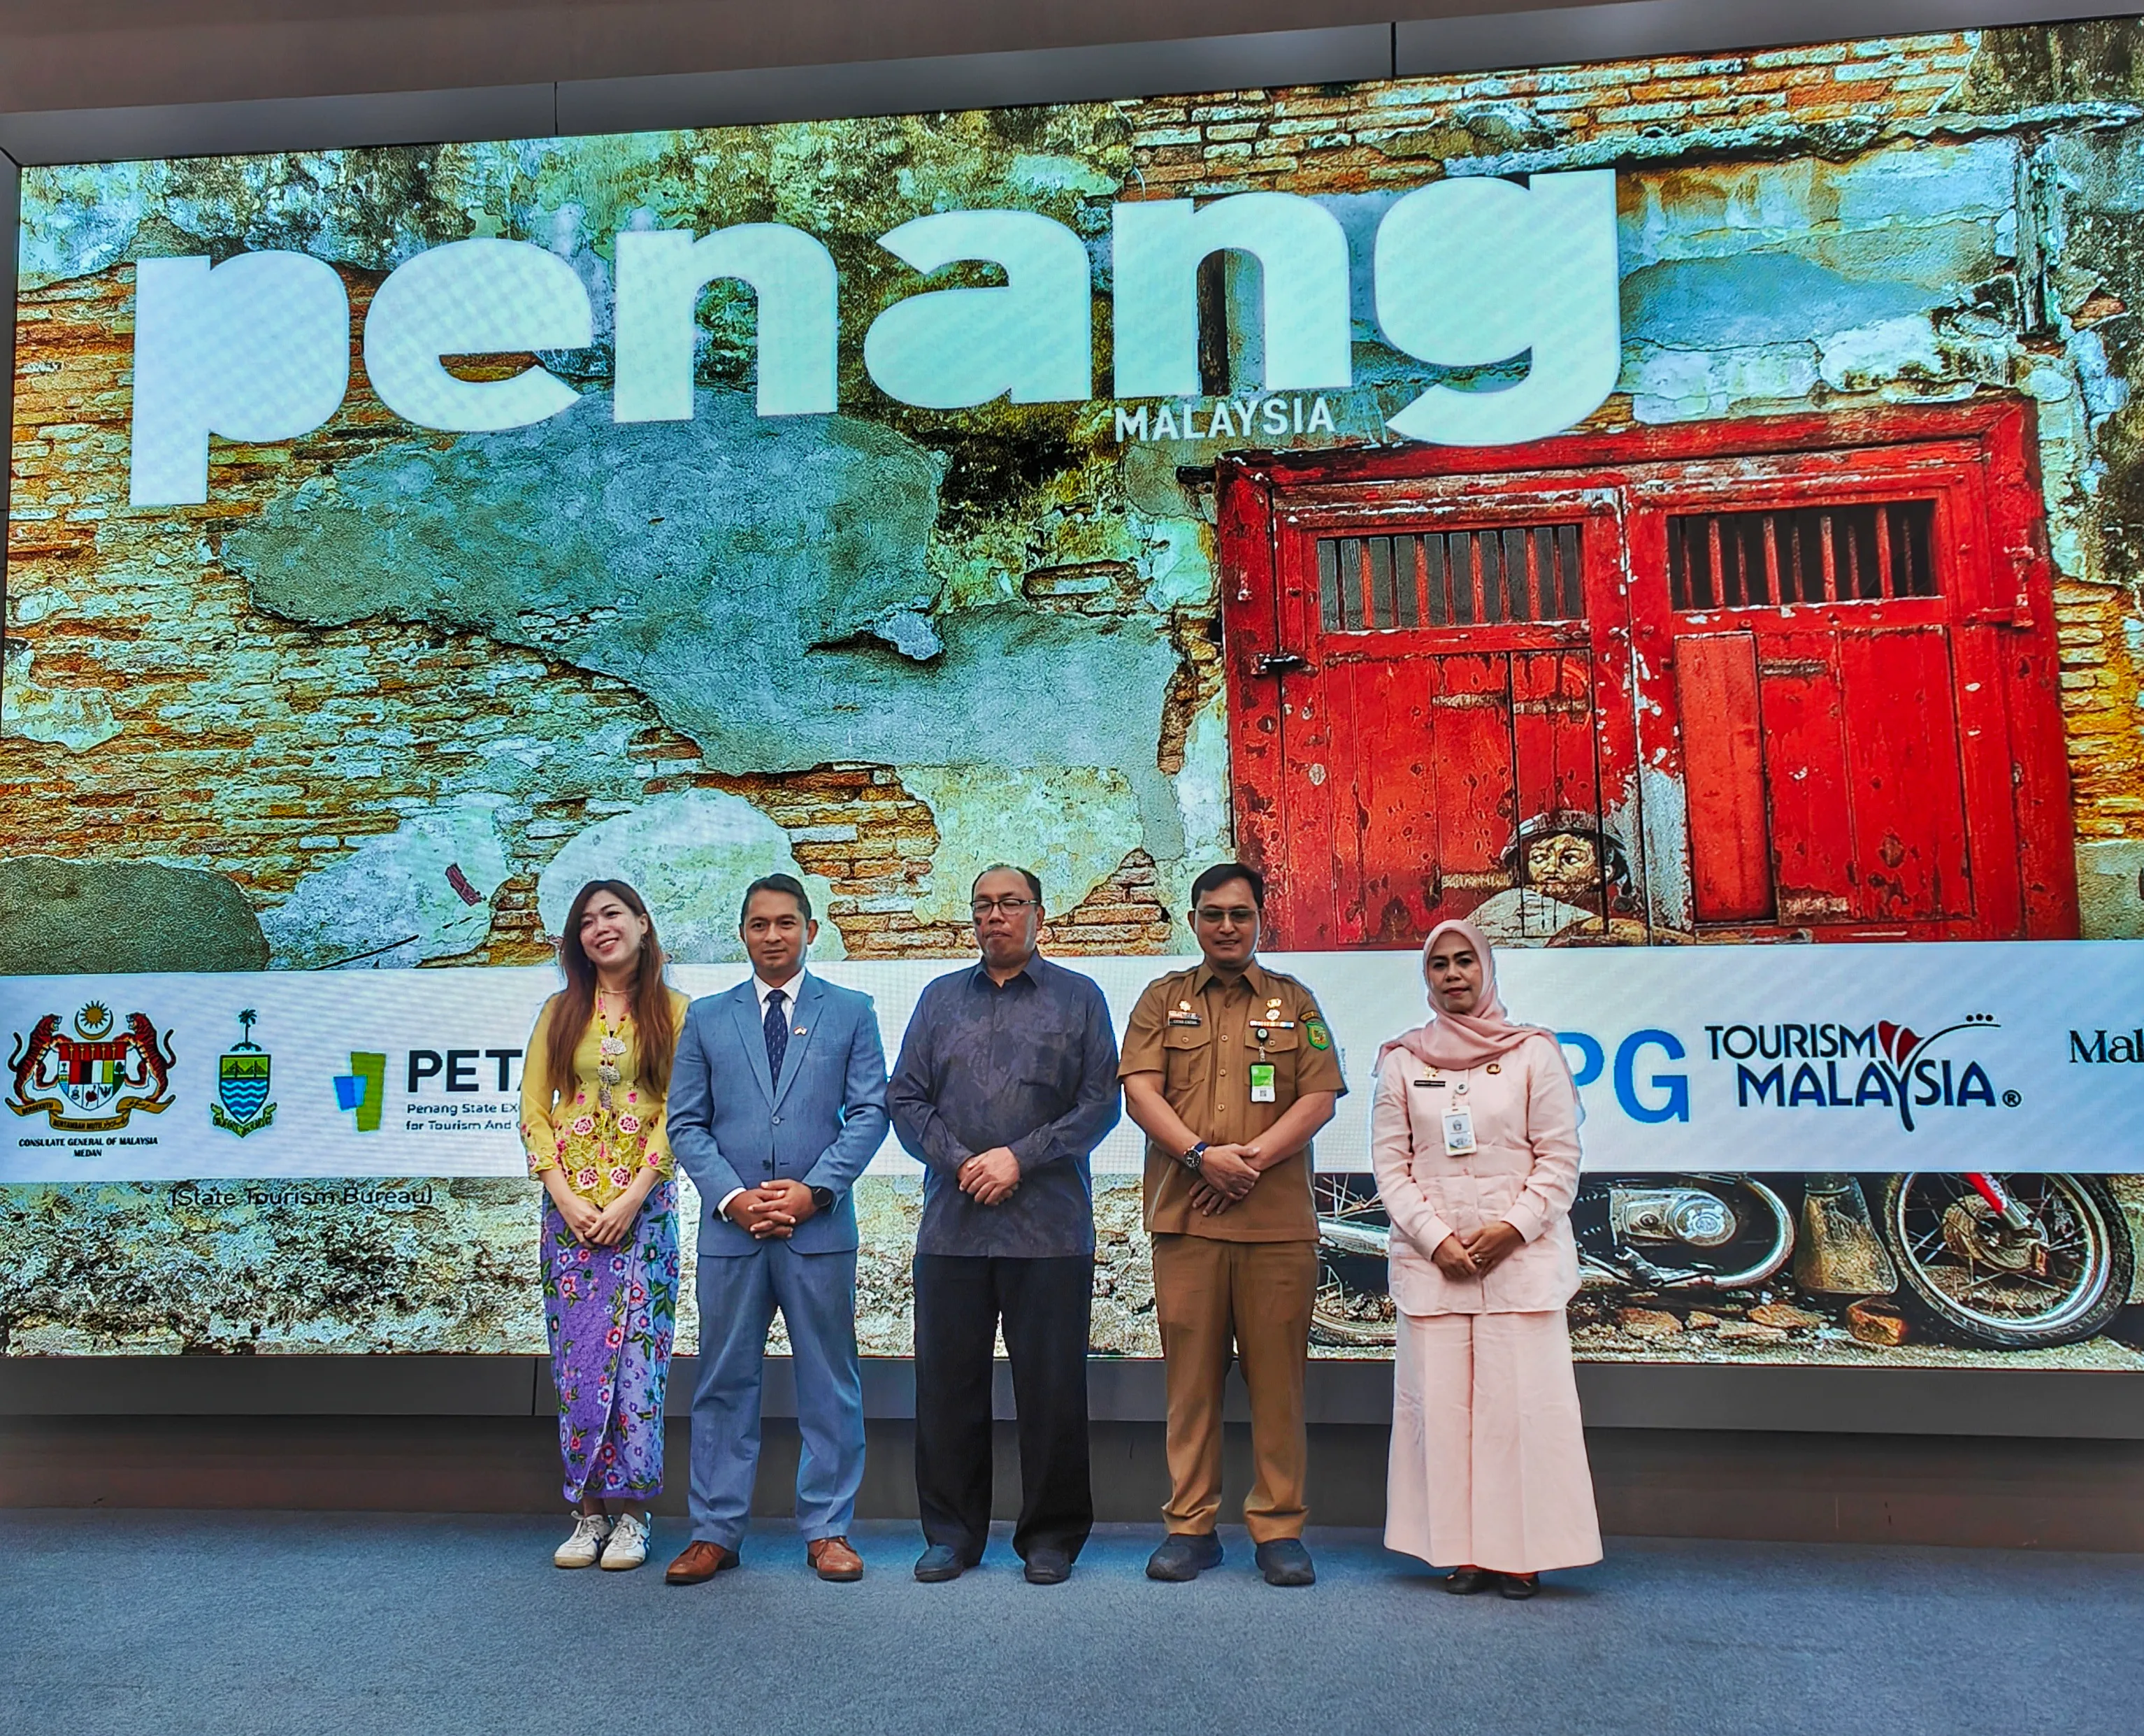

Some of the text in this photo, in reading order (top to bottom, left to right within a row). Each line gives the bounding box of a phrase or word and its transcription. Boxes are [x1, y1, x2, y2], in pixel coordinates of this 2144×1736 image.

[130, 168, 1621, 505] penang
[1115, 396, 1336, 442] MALAYSIA
[1704, 1024, 1877, 1060] TOURISM
[408, 1049, 523, 1093] PET
[407, 1103, 521, 1116] Penang State EX
[1737, 1059, 1996, 1133] MALAYSIA
[406, 1121, 424, 1130] for
[428, 1120, 481, 1130] Tourism
[484, 1120, 512, 1130] And
[19, 1138, 65, 1147] CONSULATE
[120, 1137, 158, 1145] MALAYSIA
[73, 1149, 102, 1157] MEDAN
[245, 1187, 334, 1205] Tourism
[343, 1184, 433, 1205] Bureau)
